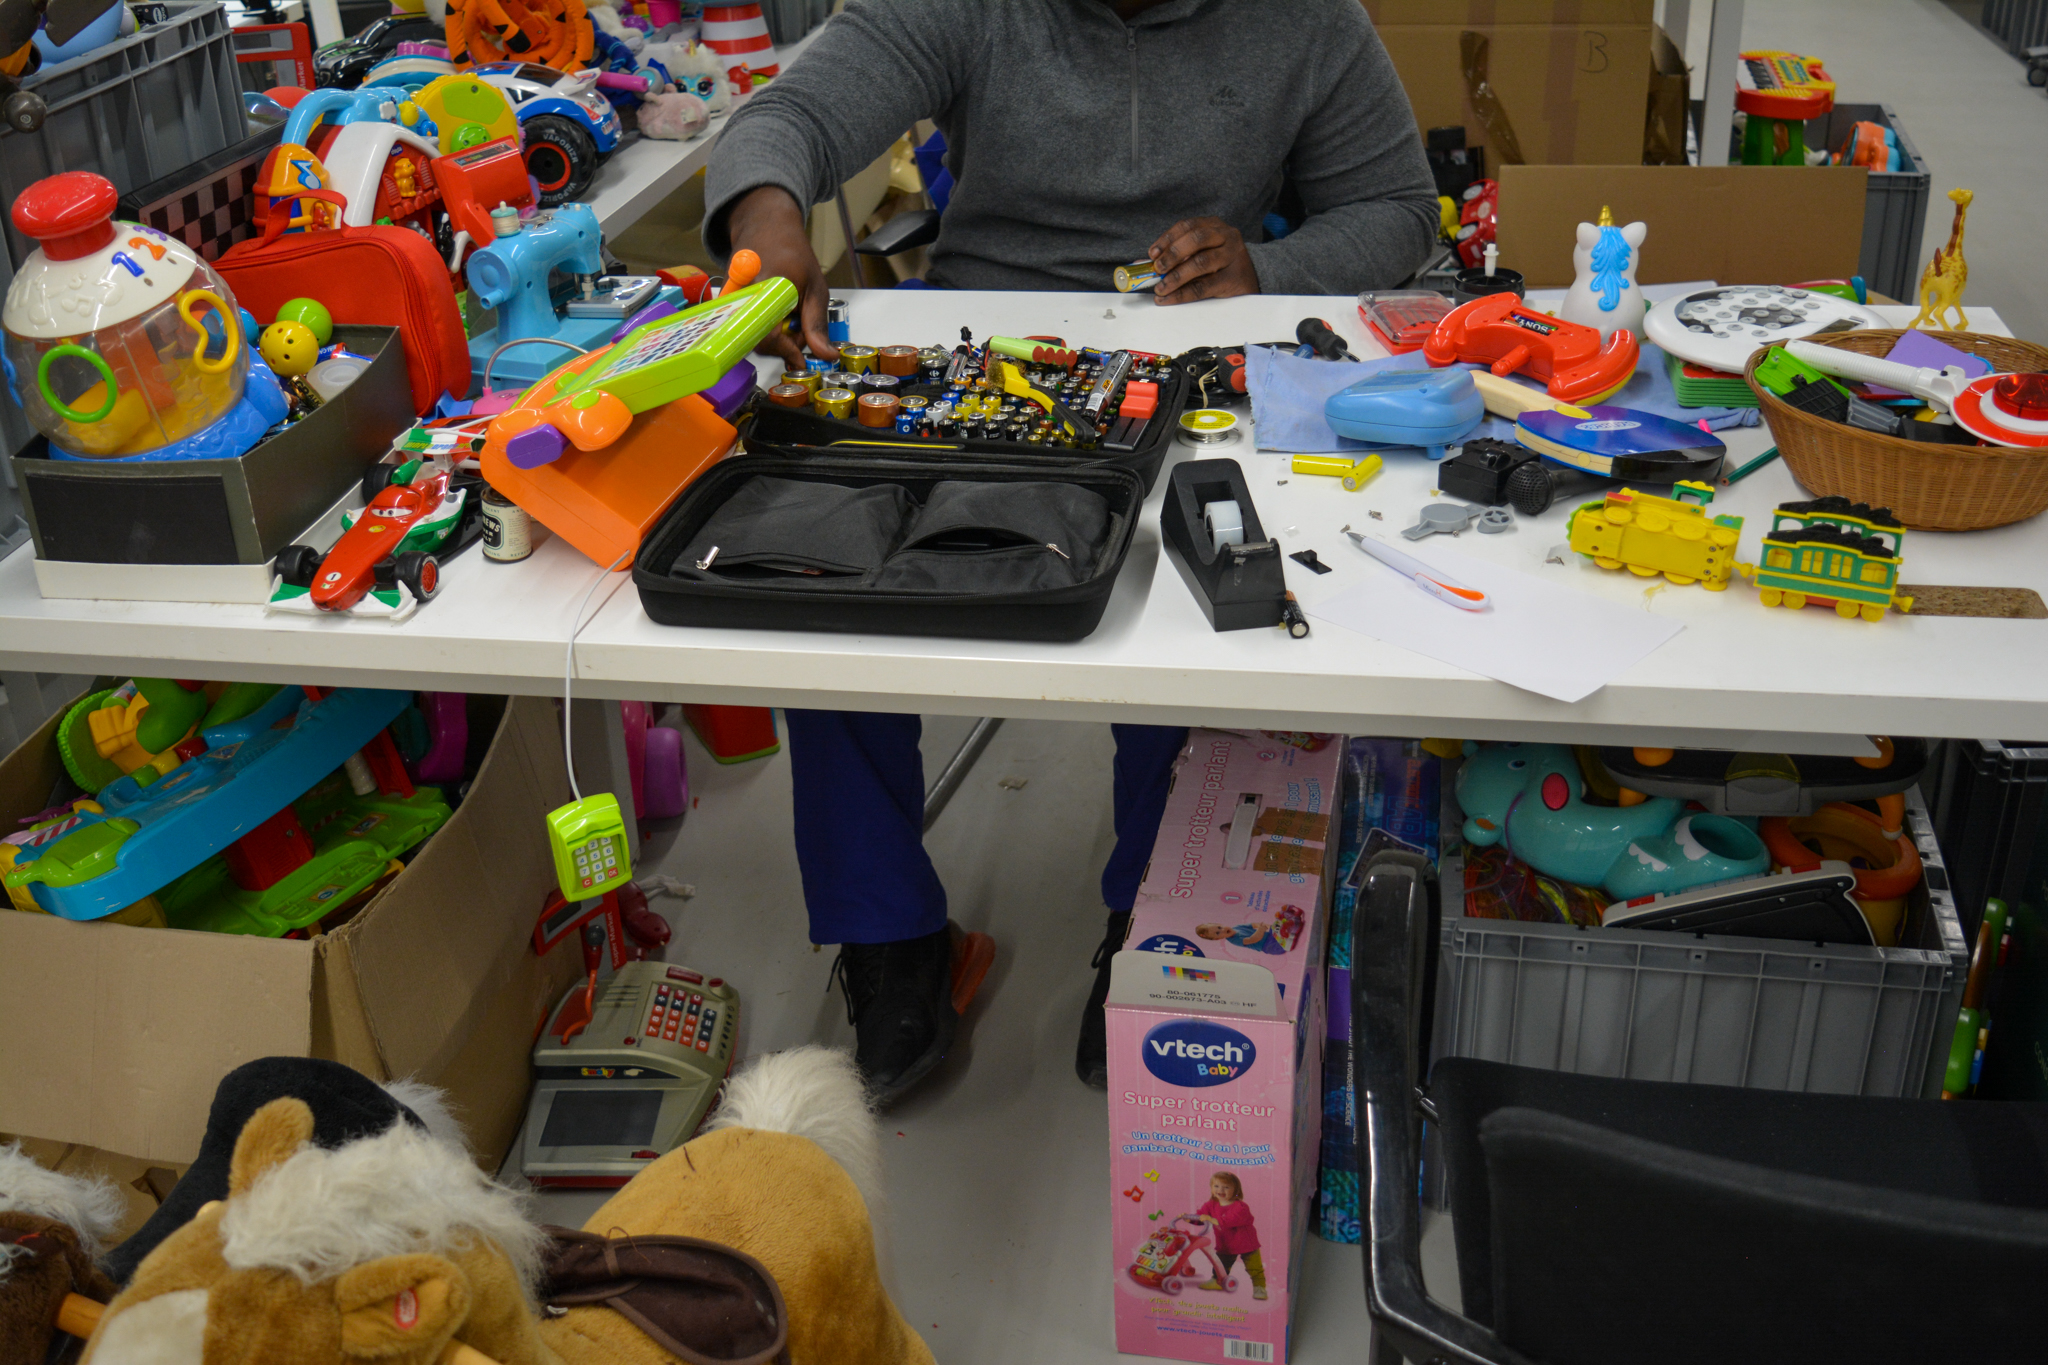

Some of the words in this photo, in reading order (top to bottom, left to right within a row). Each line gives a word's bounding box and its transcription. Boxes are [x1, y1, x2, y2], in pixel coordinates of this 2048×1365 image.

[1579, 30, 1609, 73] B
[128, 236, 167, 261] 2
[111, 251, 145, 278] 1
[1518, 318, 1549, 333] SONY
[1203, 741, 1231, 791] parlant
[1287, 782, 1301, 801] pour
[1183, 793, 1218, 848] trotteur
[1169, 852, 1201, 898] Super
[607, 911, 617, 942] Market
[1167, 989, 1221, 999] 80-061775
[581, 1068, 615, 1078] Smoby
[1197, 1063, 1238, 1078] Baby
[1346, 1062, 1354, 1092] WONDERS
[1123, 1091, 1185, 1109] Super
[1191, 1097, 1275, 1117] trotteur
[1345, 1093, 1352, 1101] OF
[1161, 1113, 1237, 1131] parlant
[1122, 1143, 1187, 1156] gambader
[1189, 1150, 1204, 1161] en
[1206, 1154, 1268, 1166] s'amusant
[1132, 1131, 1149, 1140] Un
[1152, 1131, 1202, 1148] trotteur
[1204, 1141, 1212, 1150] 2
[1215, 1144, 1230, 1153] en
[1233, 1145, 1239, 1153] 1
[1242, 1144, 1270, 1155] pour
[1156, 1325, 1240, 1339] www.vtech-jouets.com
